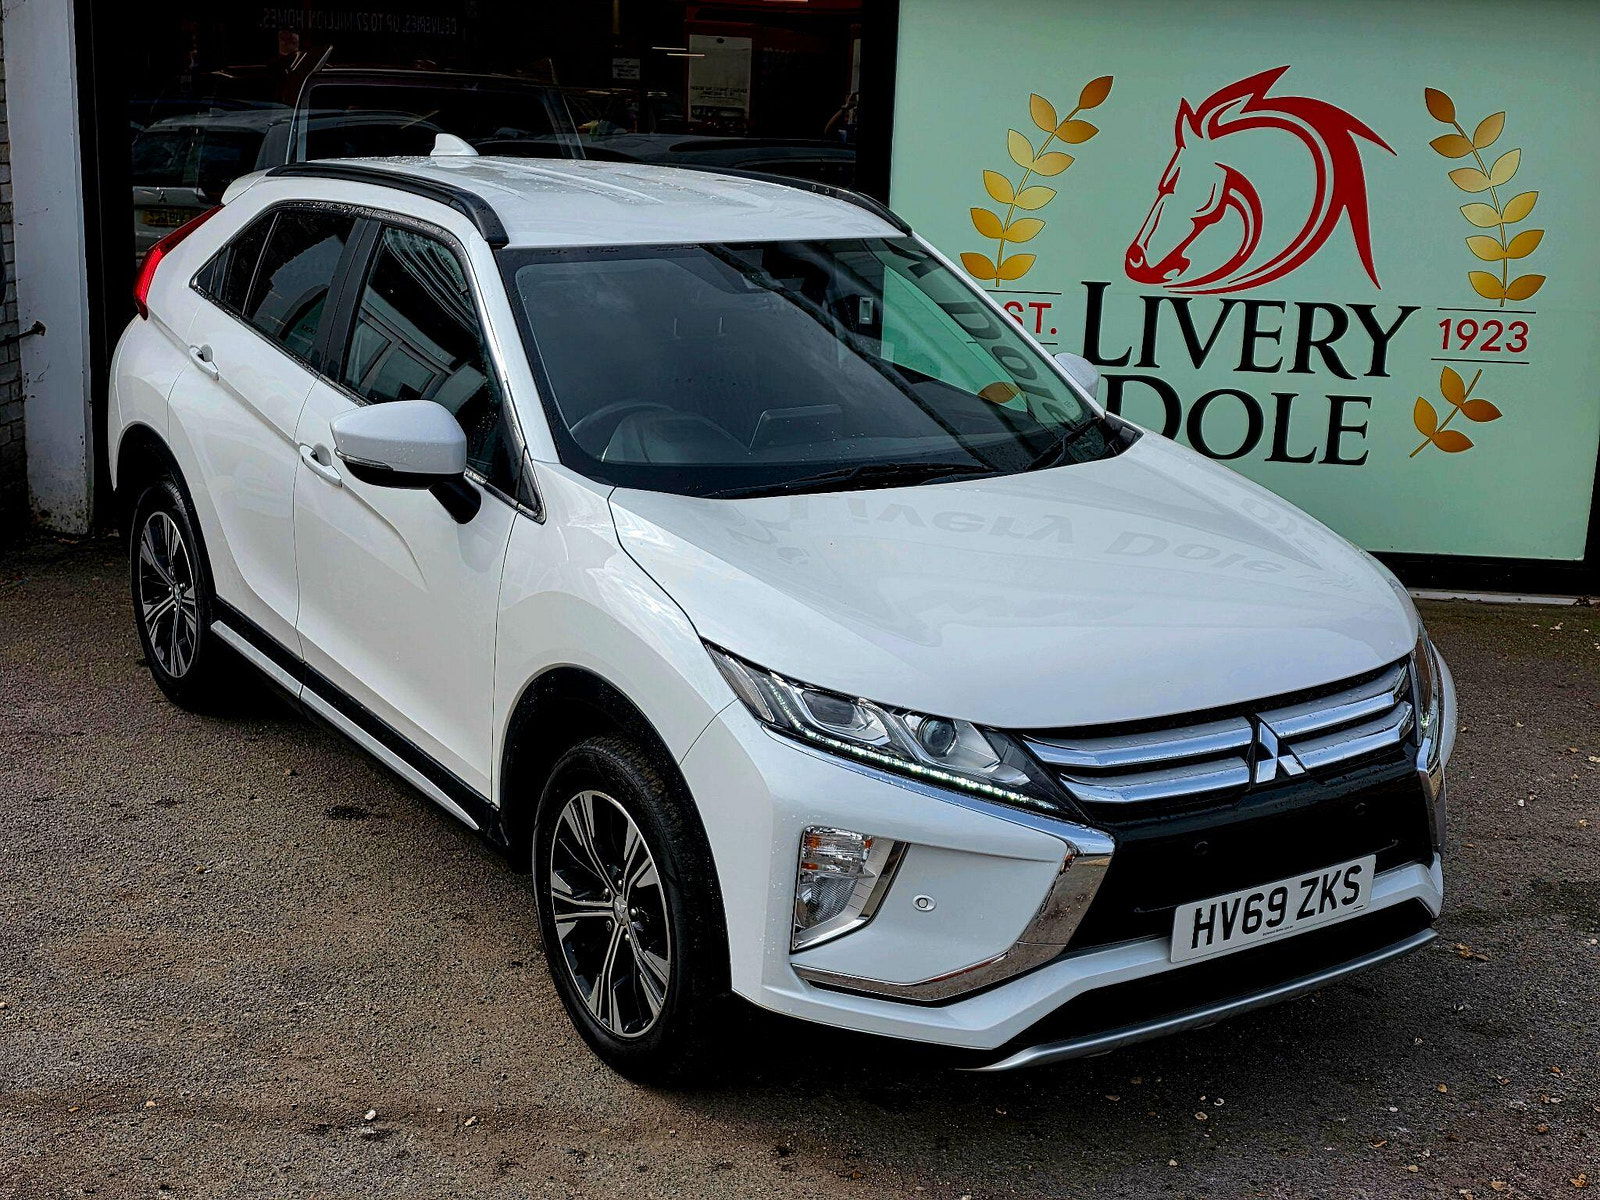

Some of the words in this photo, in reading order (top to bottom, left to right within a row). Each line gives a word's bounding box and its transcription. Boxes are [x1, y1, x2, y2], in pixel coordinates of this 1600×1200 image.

[1003, 301, 1057, 335] ST.
[1081, 280, 1422, 380] LIVERY
[1438, 318, 1530, 353] 1923
[1101, 373, 1373, 466] DOLE
[1191, 886, 1289, 949] HV69
[1296, 864, 1363, 920] ZKS
